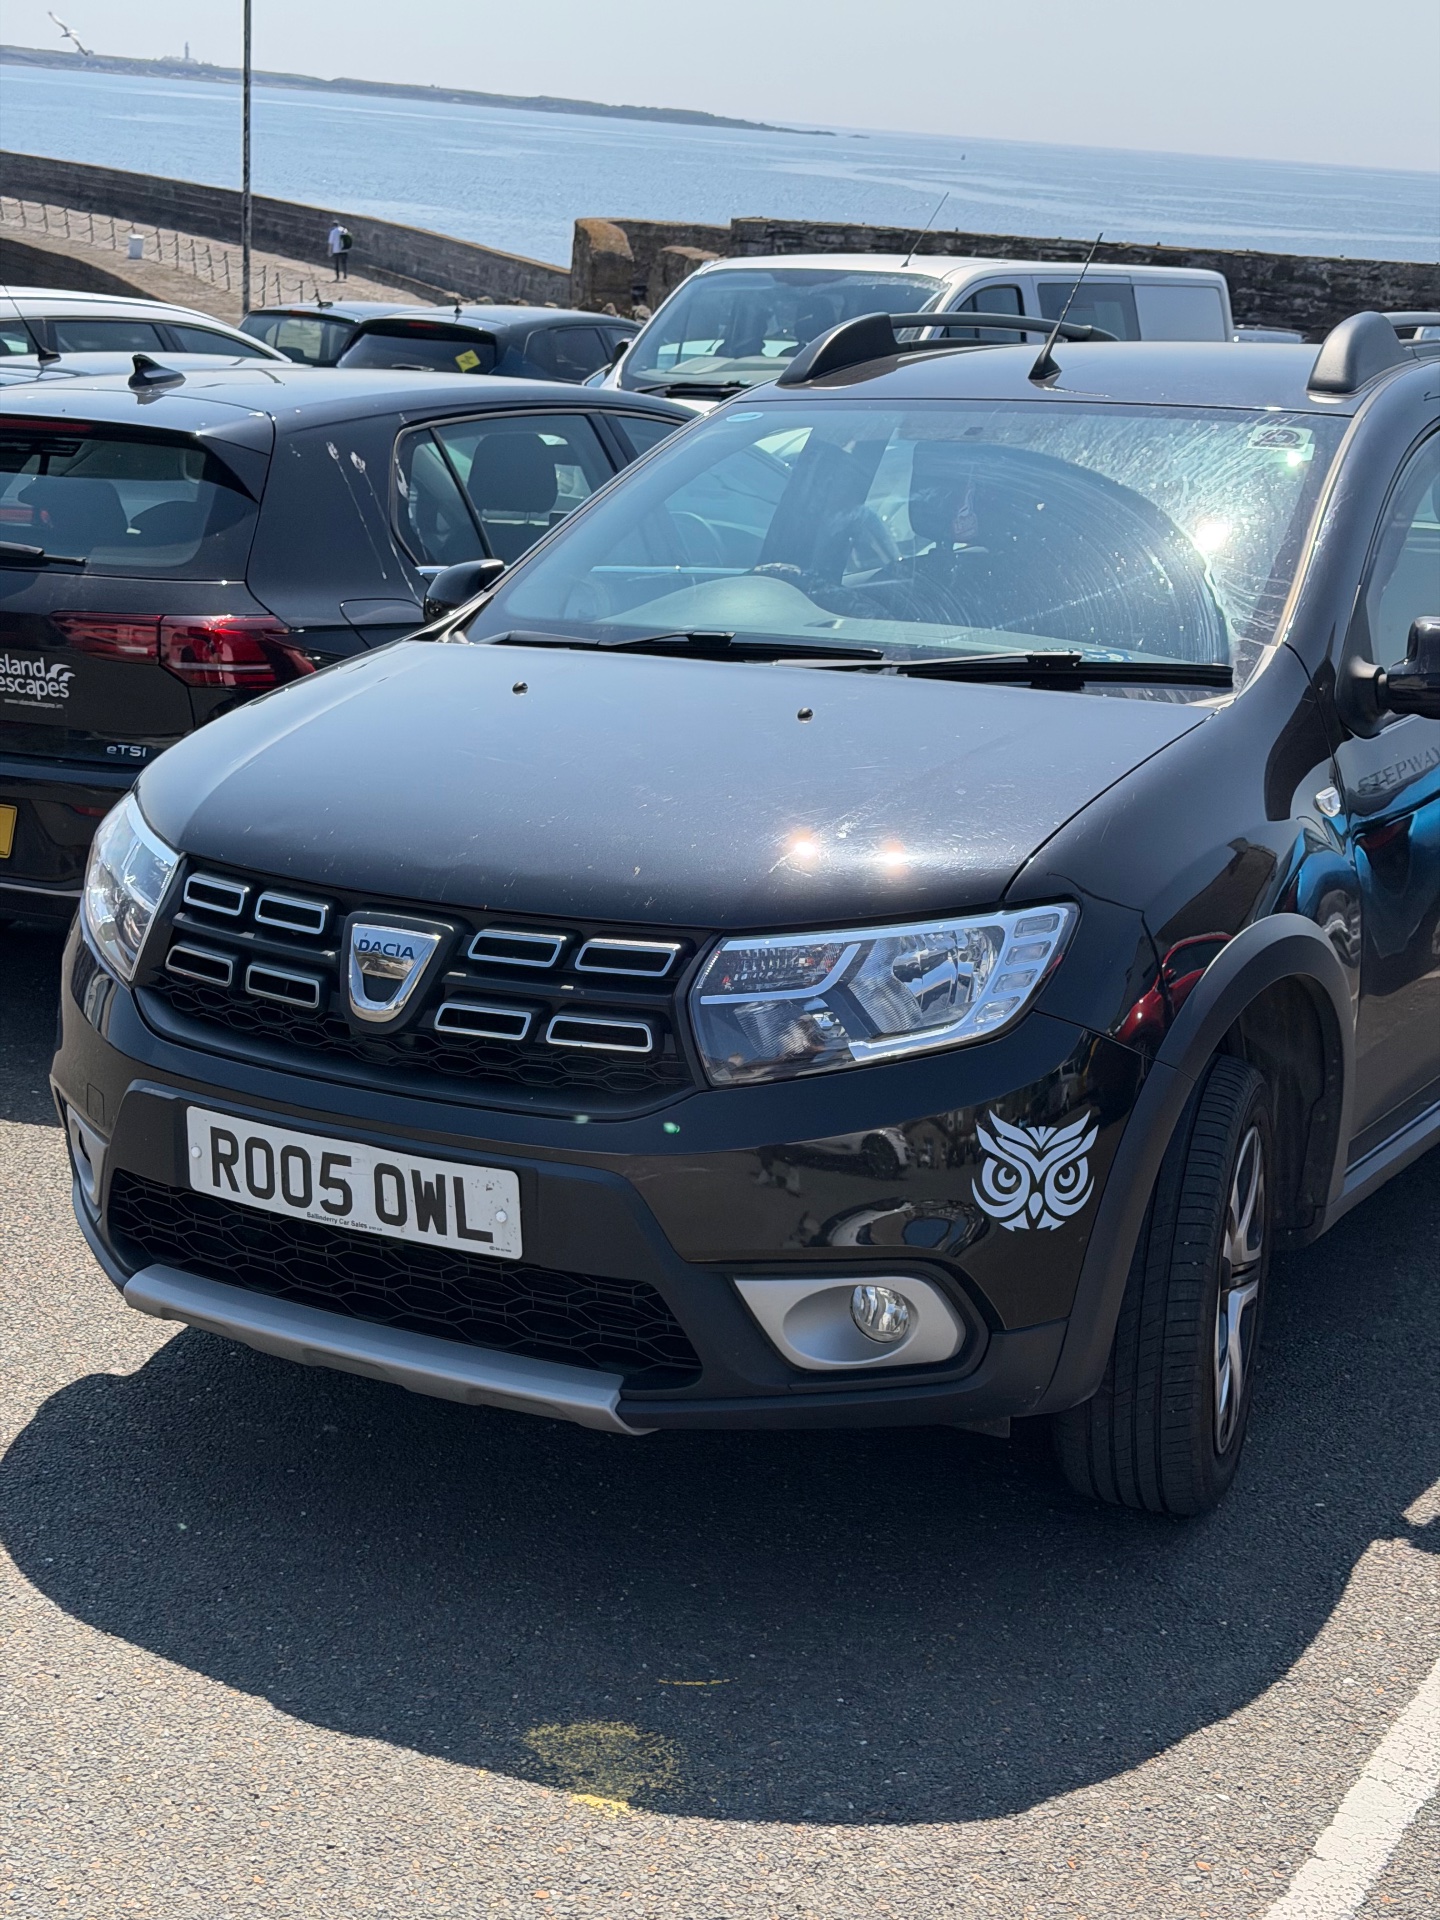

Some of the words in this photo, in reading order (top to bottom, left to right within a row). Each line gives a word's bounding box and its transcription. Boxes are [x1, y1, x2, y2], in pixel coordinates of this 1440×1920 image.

[0, 676, 70, 700] escapes
[106, 744, 147, 757] eTSI
[358, 939, 415, 960] DACIA
[374, 1162, 494, 1243] OWL
[338, 1218, 350, 1226] Car
[350, 1220, 368, 1229] Sales
